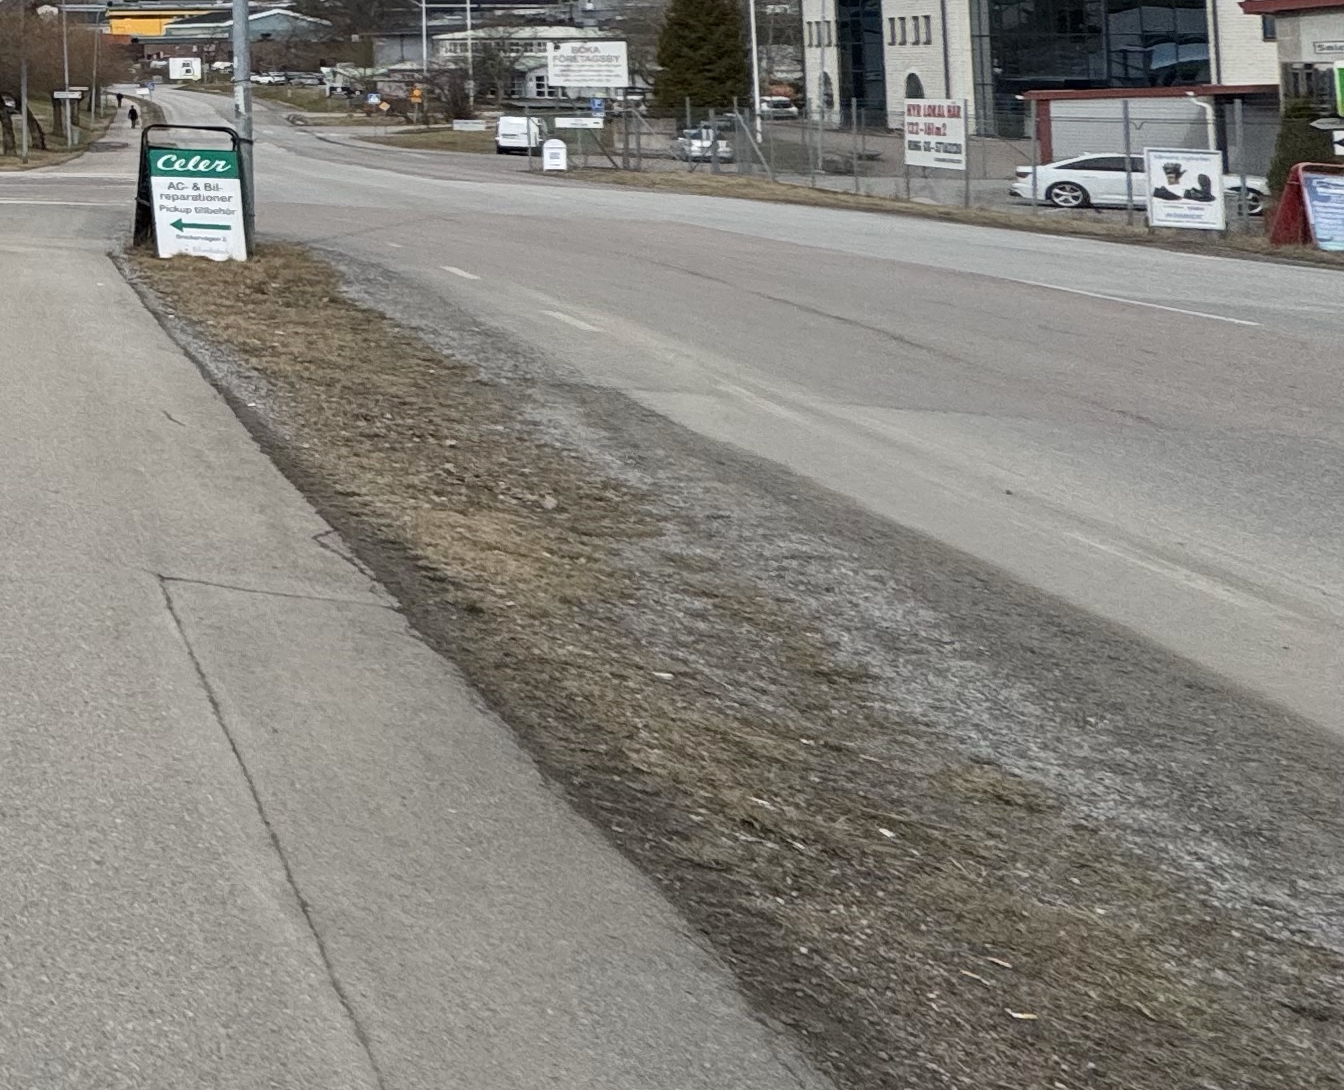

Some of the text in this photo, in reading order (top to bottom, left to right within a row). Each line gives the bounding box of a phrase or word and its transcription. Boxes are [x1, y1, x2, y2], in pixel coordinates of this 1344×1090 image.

[923, 104, 946, 118] LOKAL
[156, 154, 232, 172] Celer
[192, 182, 201, 192] &
[204, 182, 223, 192] Bil-
[159, 193, 234, 203] reparationer
[159, 204, 192, 215] Pickup
